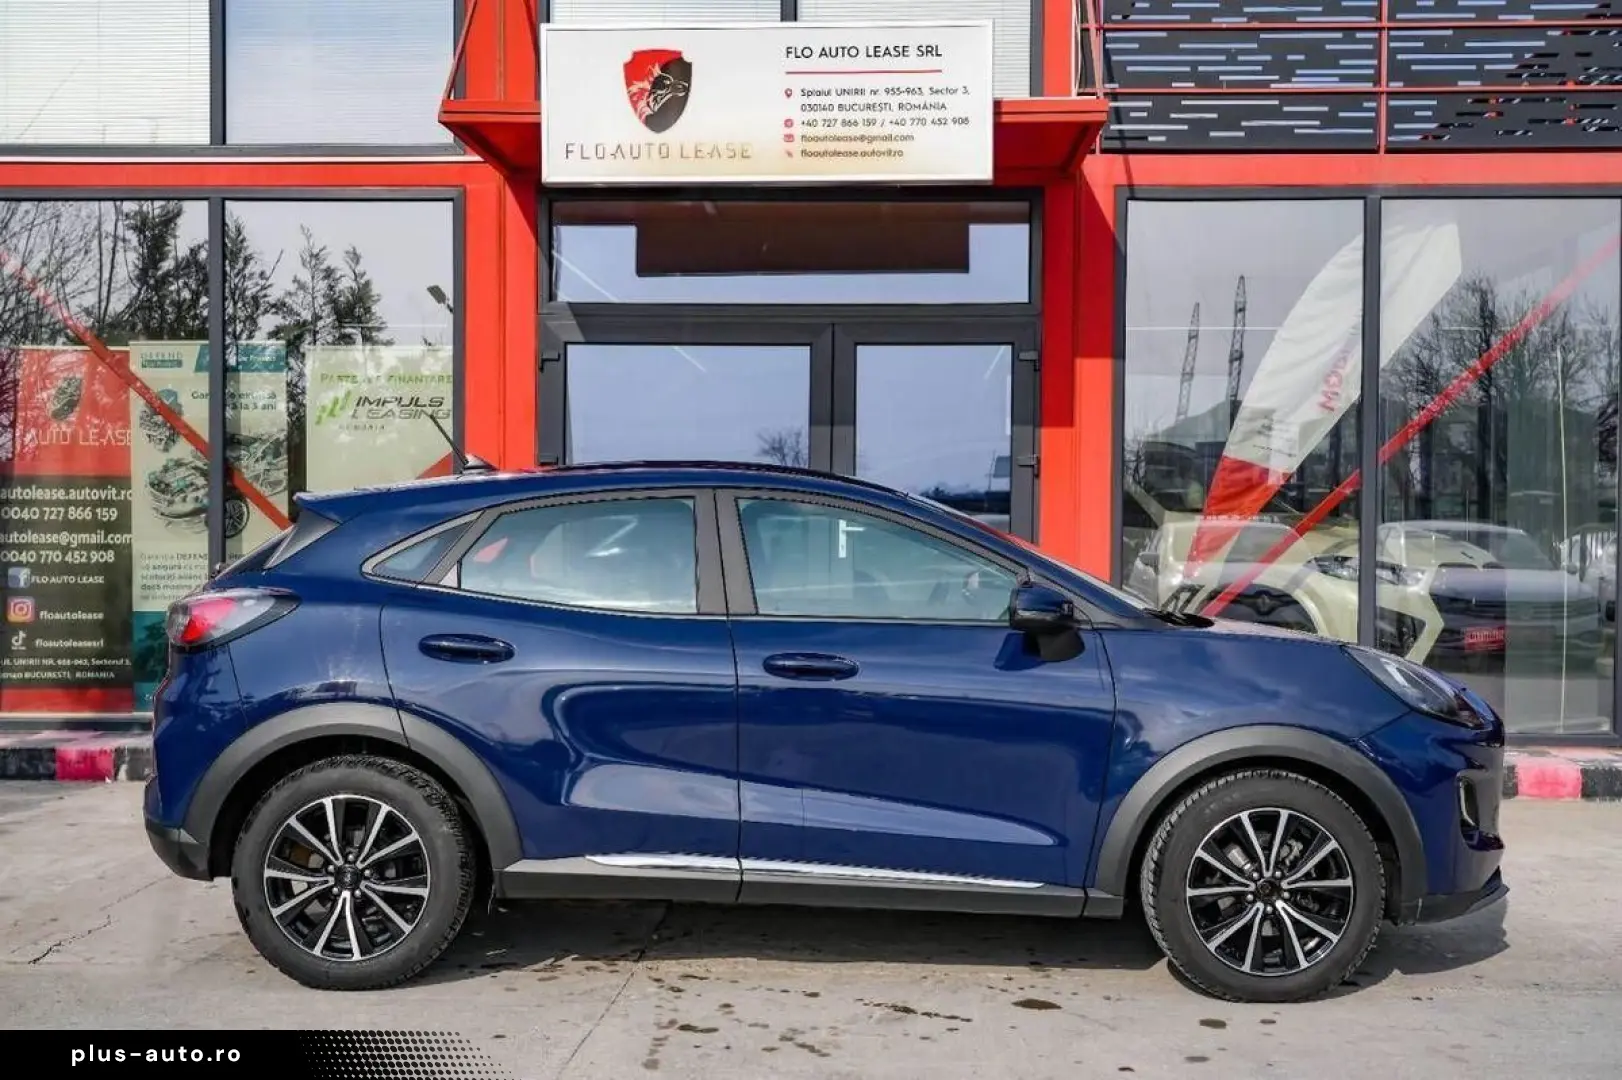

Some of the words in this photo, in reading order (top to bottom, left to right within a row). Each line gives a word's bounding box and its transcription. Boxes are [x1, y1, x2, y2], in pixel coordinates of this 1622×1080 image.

[785, 46, 813, 59] FLO
[818, 45, 859, 58] AUTO
[866, 45, 910, 58] LEASE
[916, 44, 942, 57] SRL
[801, 88, 831, 98] Splaiul
[835, 88, 865, 96] UNIRII
[929, 86, 958, 96] Sector
[801, 119, 818, 128] +40
[822, 118, 838, 127] 727
[841, 118, 858, 127] 866
[862, 118, 877, 127] 159
[889, 118, 906, 127] +40
[910, 117, 926, 127] 770
[930, 116, 948, 126] 452
[680, 141, 753, 160] LEASE
[356, 396, 446, 408] IMPULS
[351, 409, 452, 420] LEASING
[0, 507, 40, 520] 0040
[42, 507, 65, 521] 727
[68, 506, 93, 520] 866
[96, 507, 118, 521] 159
[0, 550, 36, 564] 0040
[40, 550, 61, 564] 770
[65, 550, 88, 564] 452
[90, 550, 115, 563] 908
[50, 574, 76, 584] AUTO
[77, 574, 105, 584] LEASE
